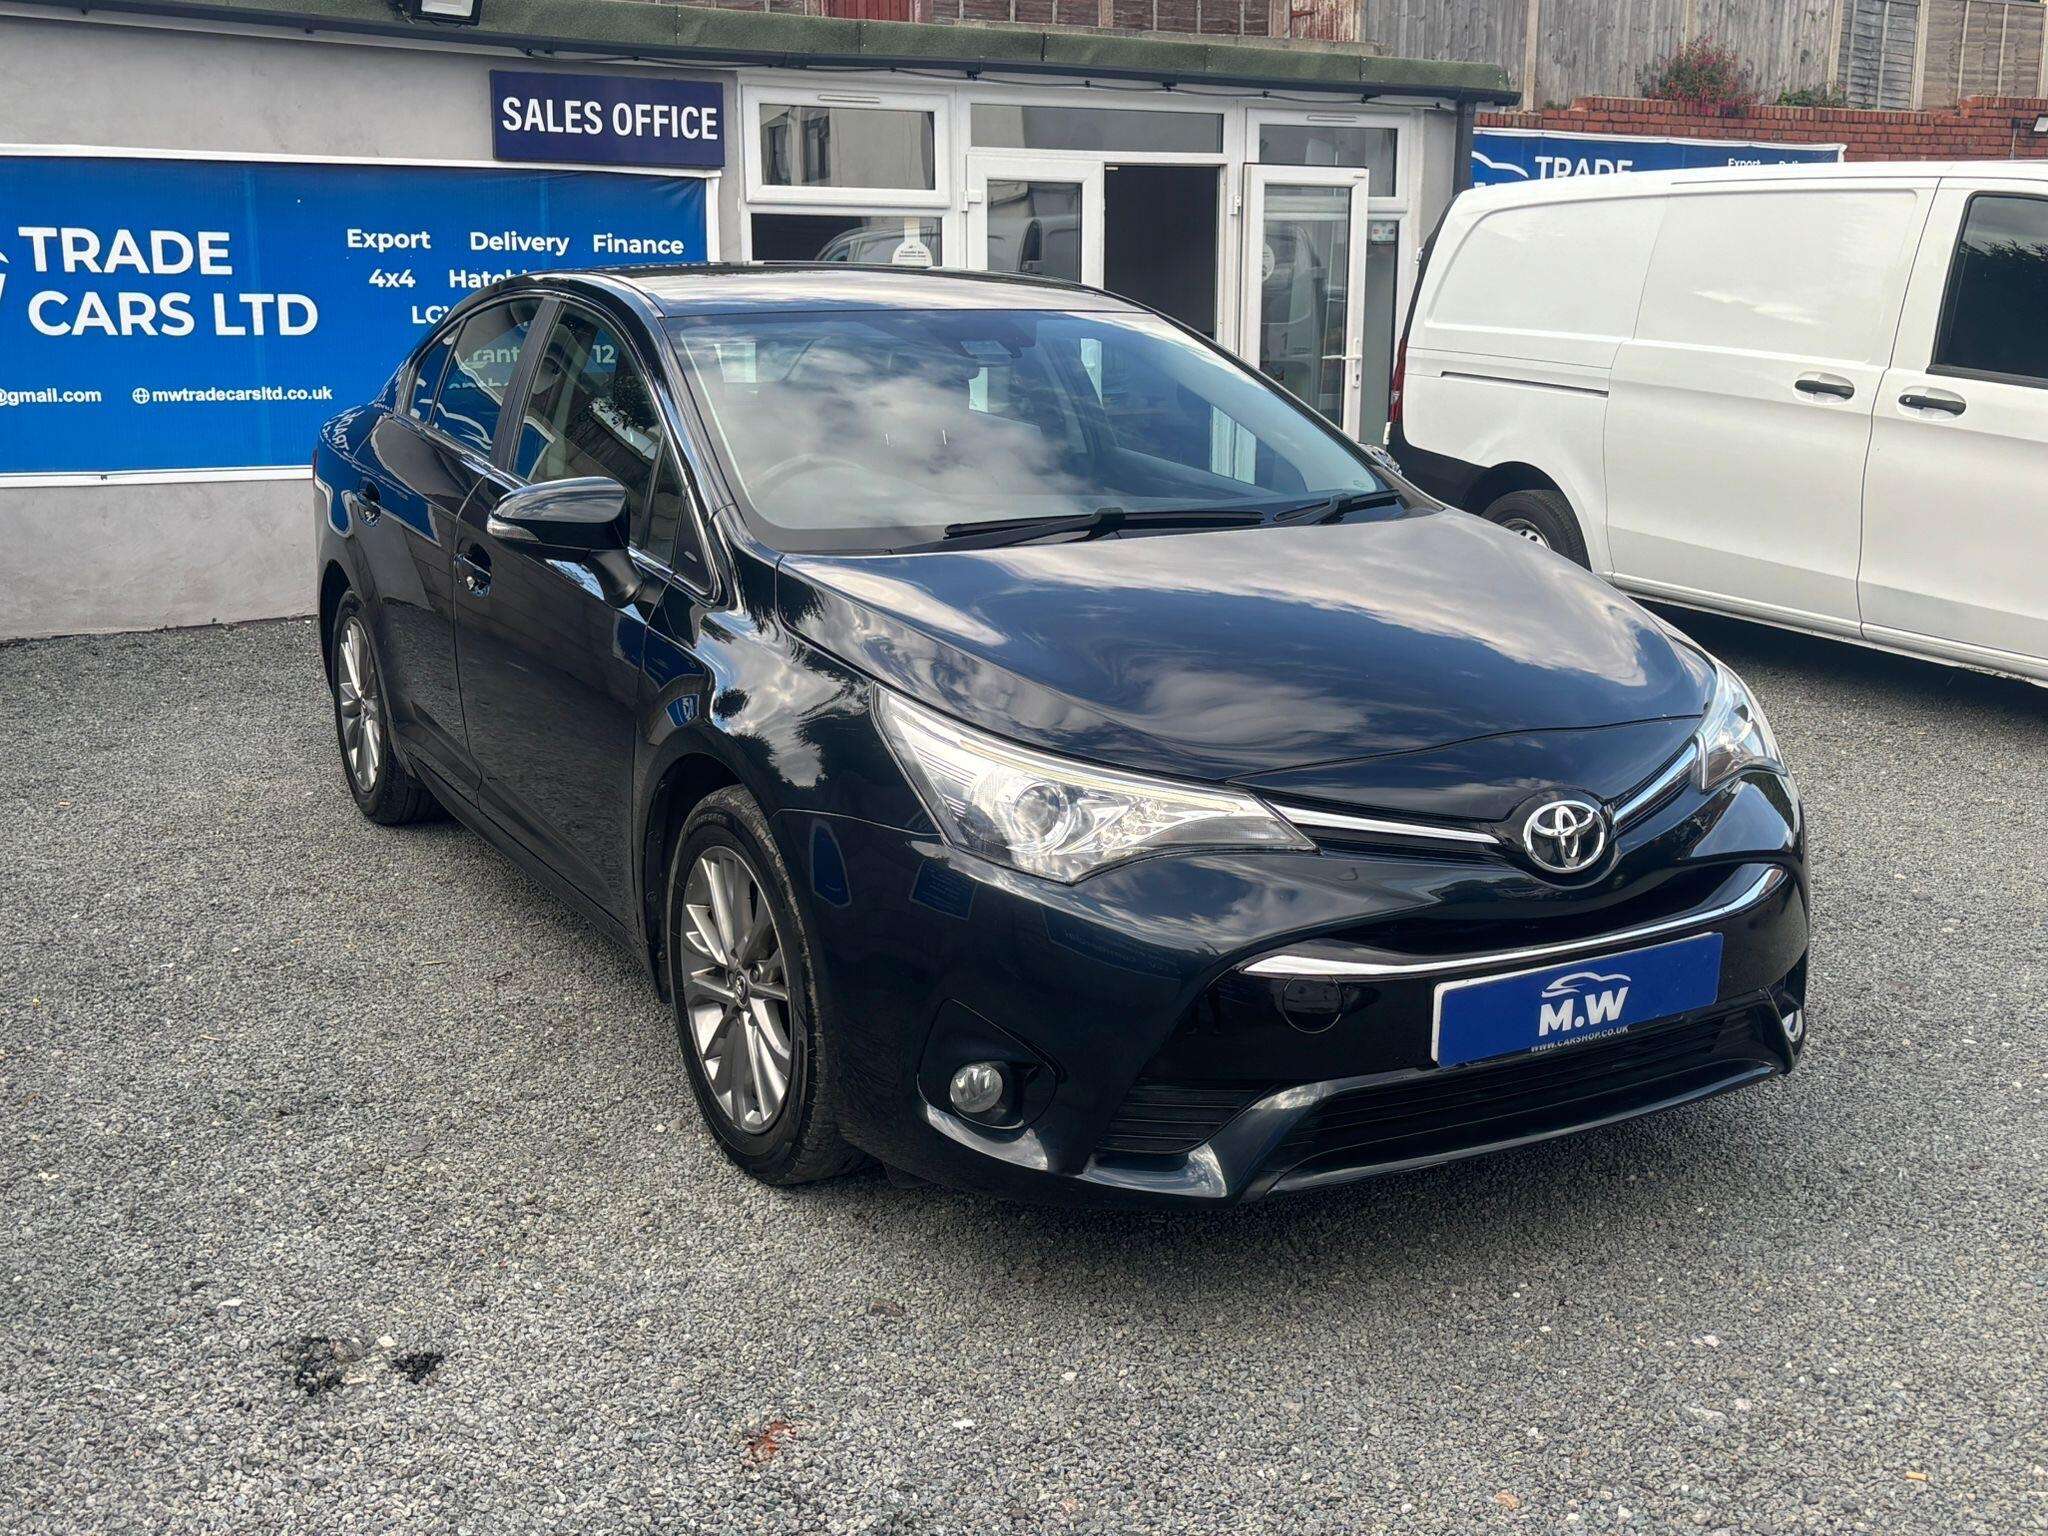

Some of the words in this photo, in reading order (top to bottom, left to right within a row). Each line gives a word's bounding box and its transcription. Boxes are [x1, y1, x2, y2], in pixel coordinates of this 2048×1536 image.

[502, 96, 603, 135] SALES
[612, 102, 718, 141] OFFICE
[17, 226, 233, 275] TRADE
[346, 228, 432, 253] Export
[469, 230, 570, 257] Delivery
[592, 233, 685, 255] Finance
[368, 268, 416, 288] 4x4
[448, 269, 528, 288] Hatc
[28, 290, 196, 336] CARS
[213, 292, 319, 336] LTD
[152, 385, 333, 402] mwtradecarsltd.co.uk
[1538, 986, 1629, 1037] M.W
